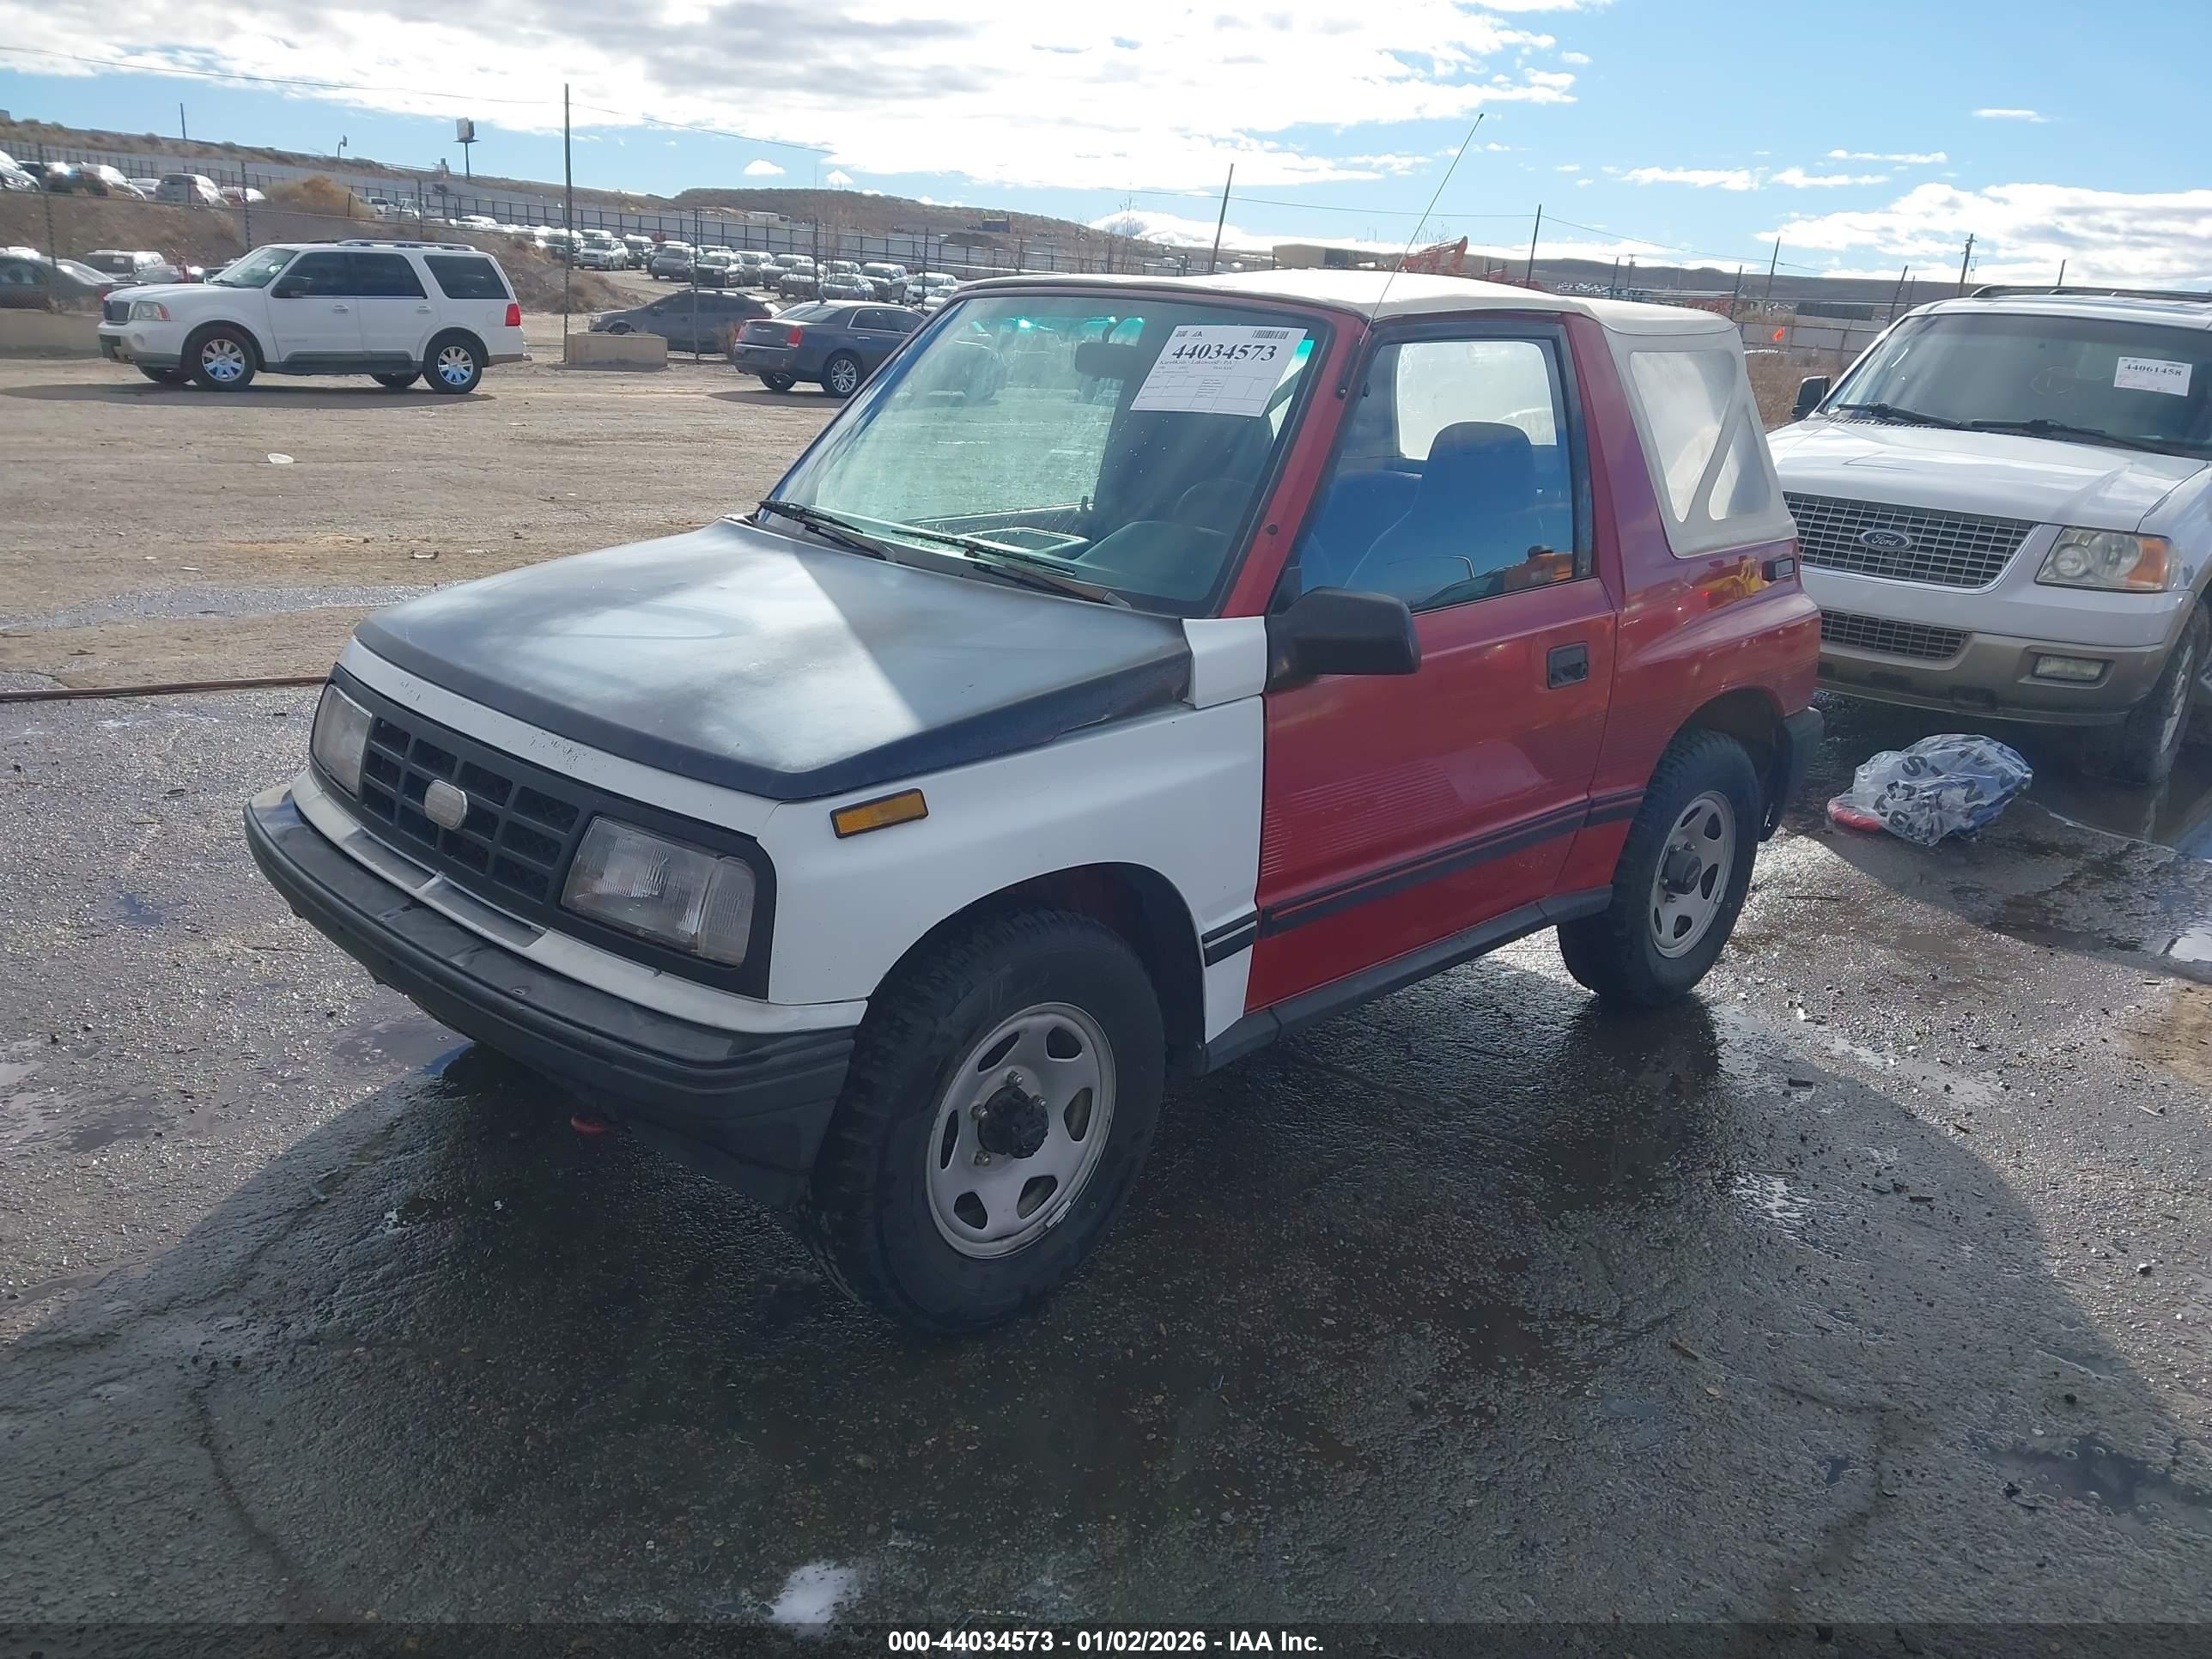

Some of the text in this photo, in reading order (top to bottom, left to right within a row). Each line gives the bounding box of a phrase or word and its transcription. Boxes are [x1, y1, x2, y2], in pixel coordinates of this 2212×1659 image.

[1171, 343, 1278, 361] 44034573
[2124, 363, 2182, 376] 44061458
[1872, 533, 1899, 546] Ford
